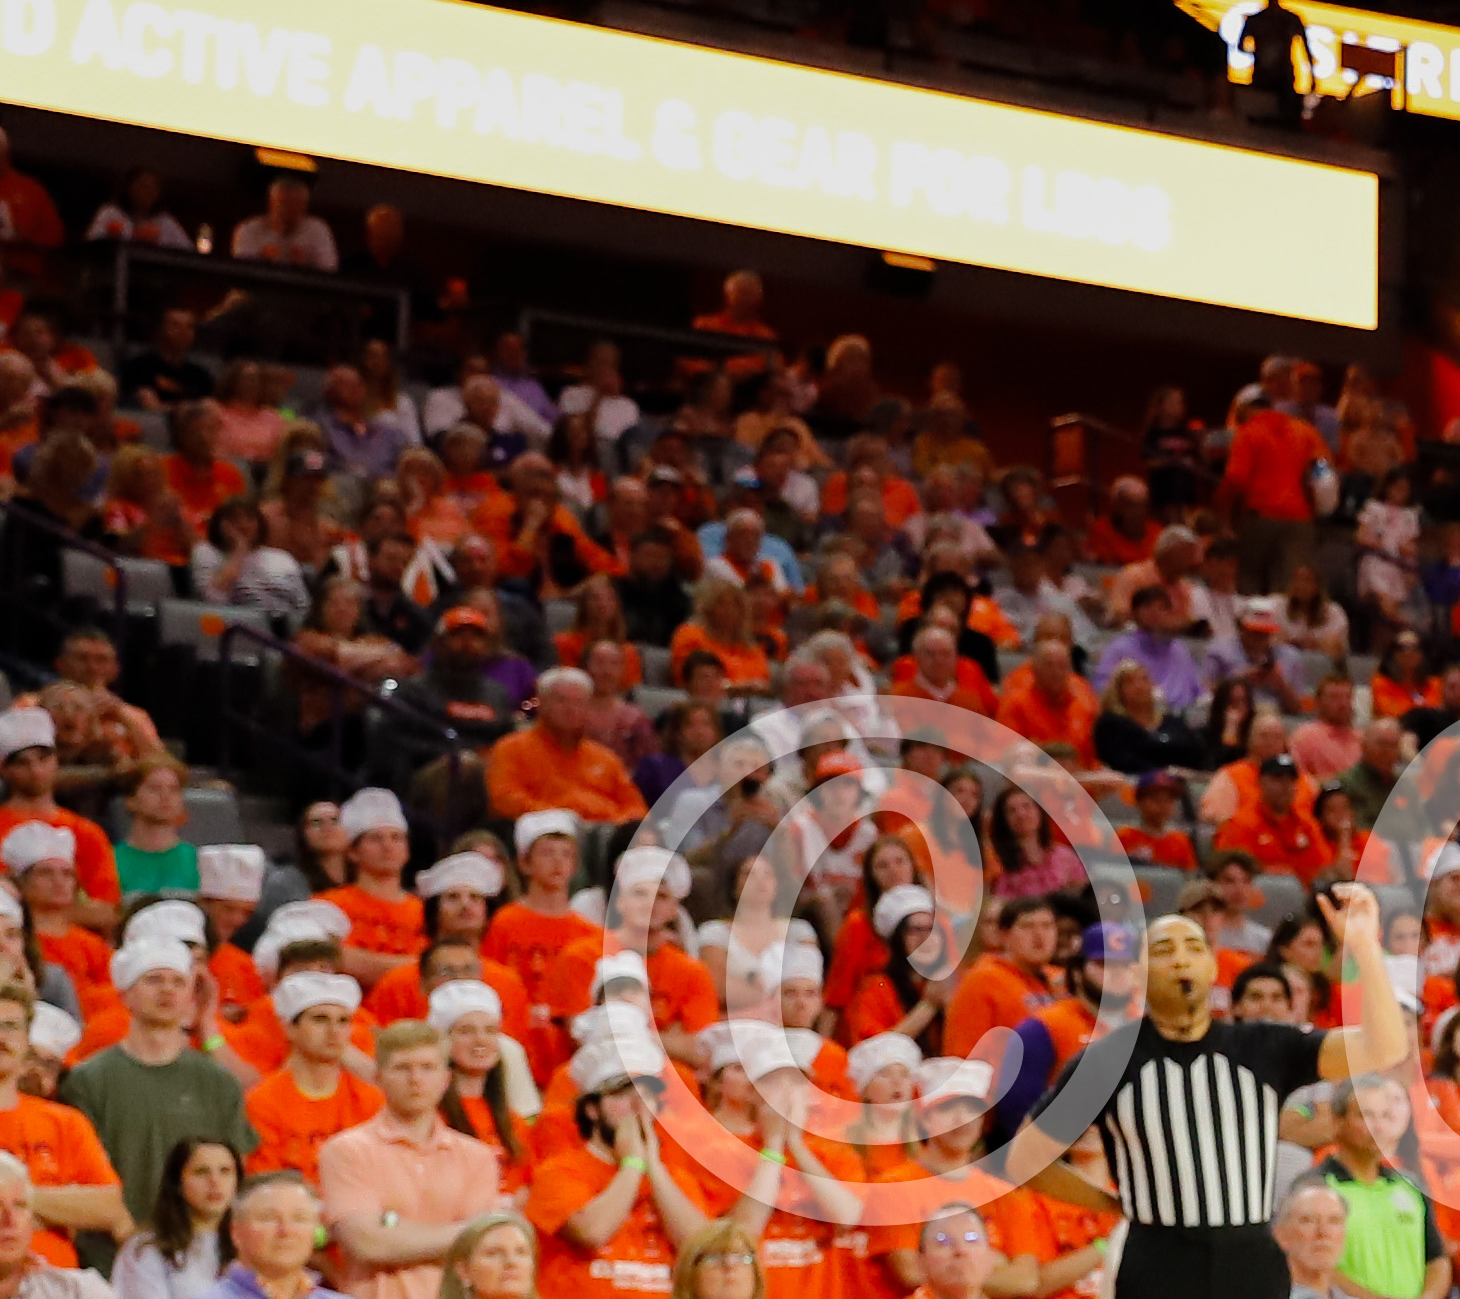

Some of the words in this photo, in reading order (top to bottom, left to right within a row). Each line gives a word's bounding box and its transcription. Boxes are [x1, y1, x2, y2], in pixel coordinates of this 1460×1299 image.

[342, 43, 642, 163] APPAREL
[651, 98, 700, 172] &
[712, 108, 877, 203] GEAR
